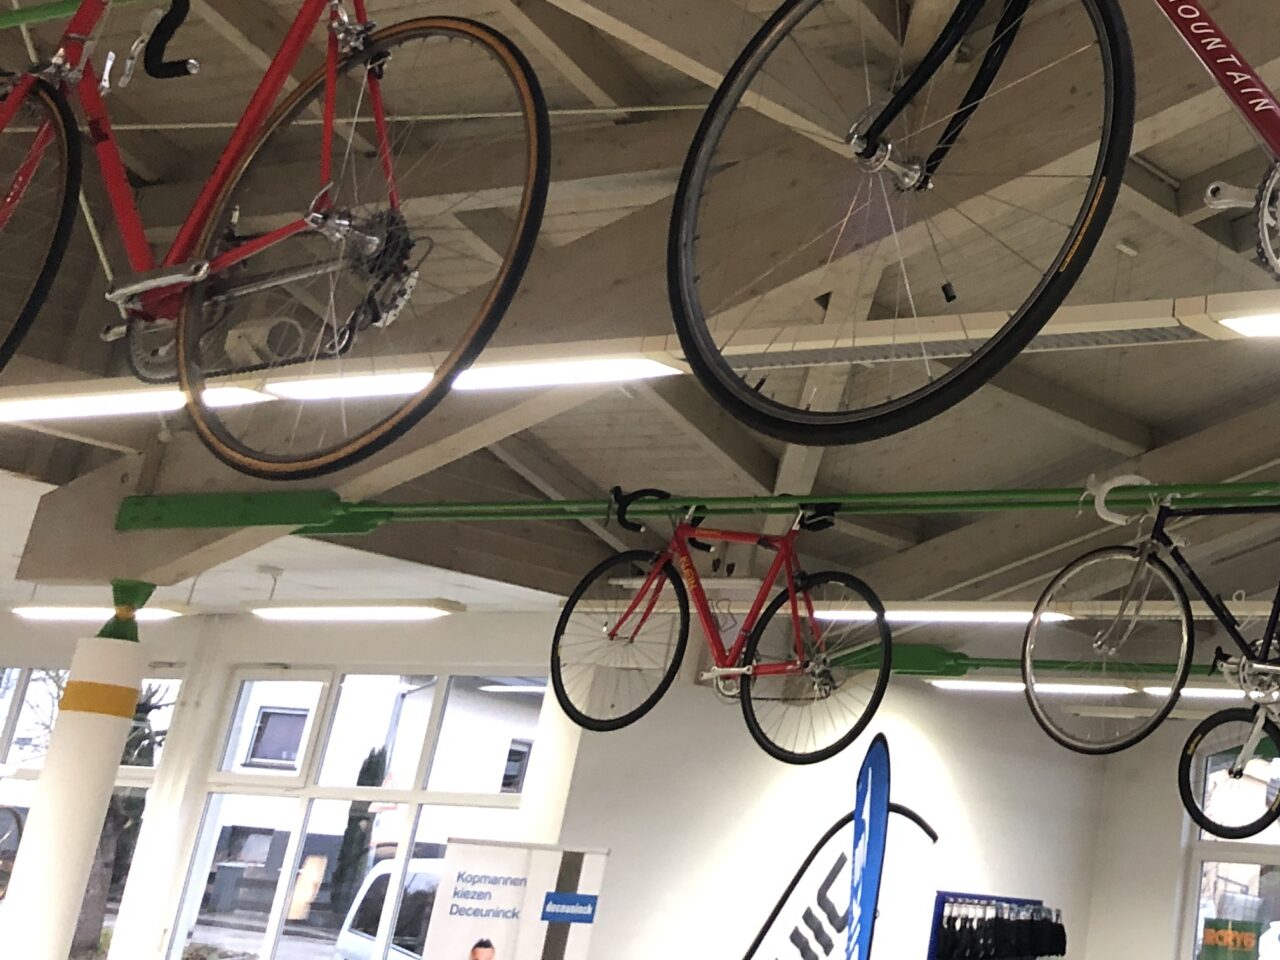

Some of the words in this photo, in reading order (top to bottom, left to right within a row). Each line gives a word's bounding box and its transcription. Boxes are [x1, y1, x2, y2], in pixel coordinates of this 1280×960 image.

[457, 871, 528, 888] Kopmannen
[453, 887, 492, 901] kiezen
[450, 904, 521, 920] Deceuninck
